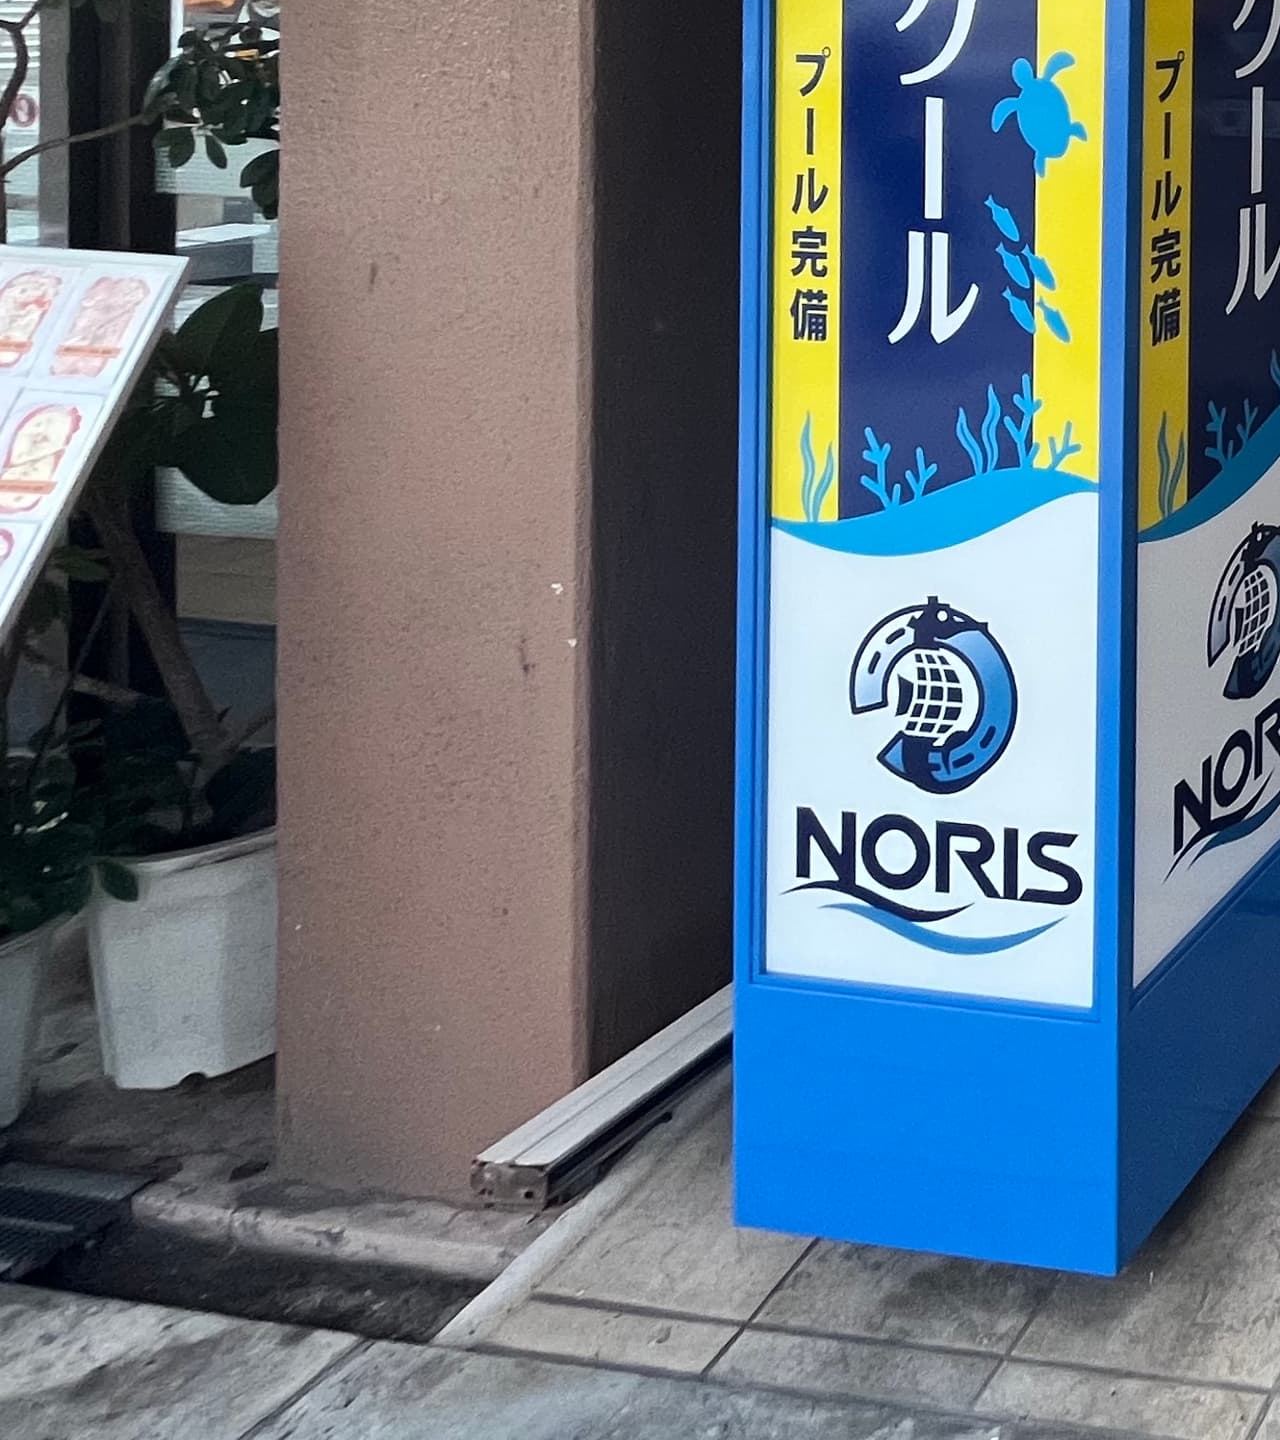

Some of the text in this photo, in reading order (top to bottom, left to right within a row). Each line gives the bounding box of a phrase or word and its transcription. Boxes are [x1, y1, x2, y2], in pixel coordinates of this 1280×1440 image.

[790, 45, 831, 344] プール完備
[1149, 51, 1186, 348] プール完備
[796, 806, 1084, 906] NORIS
